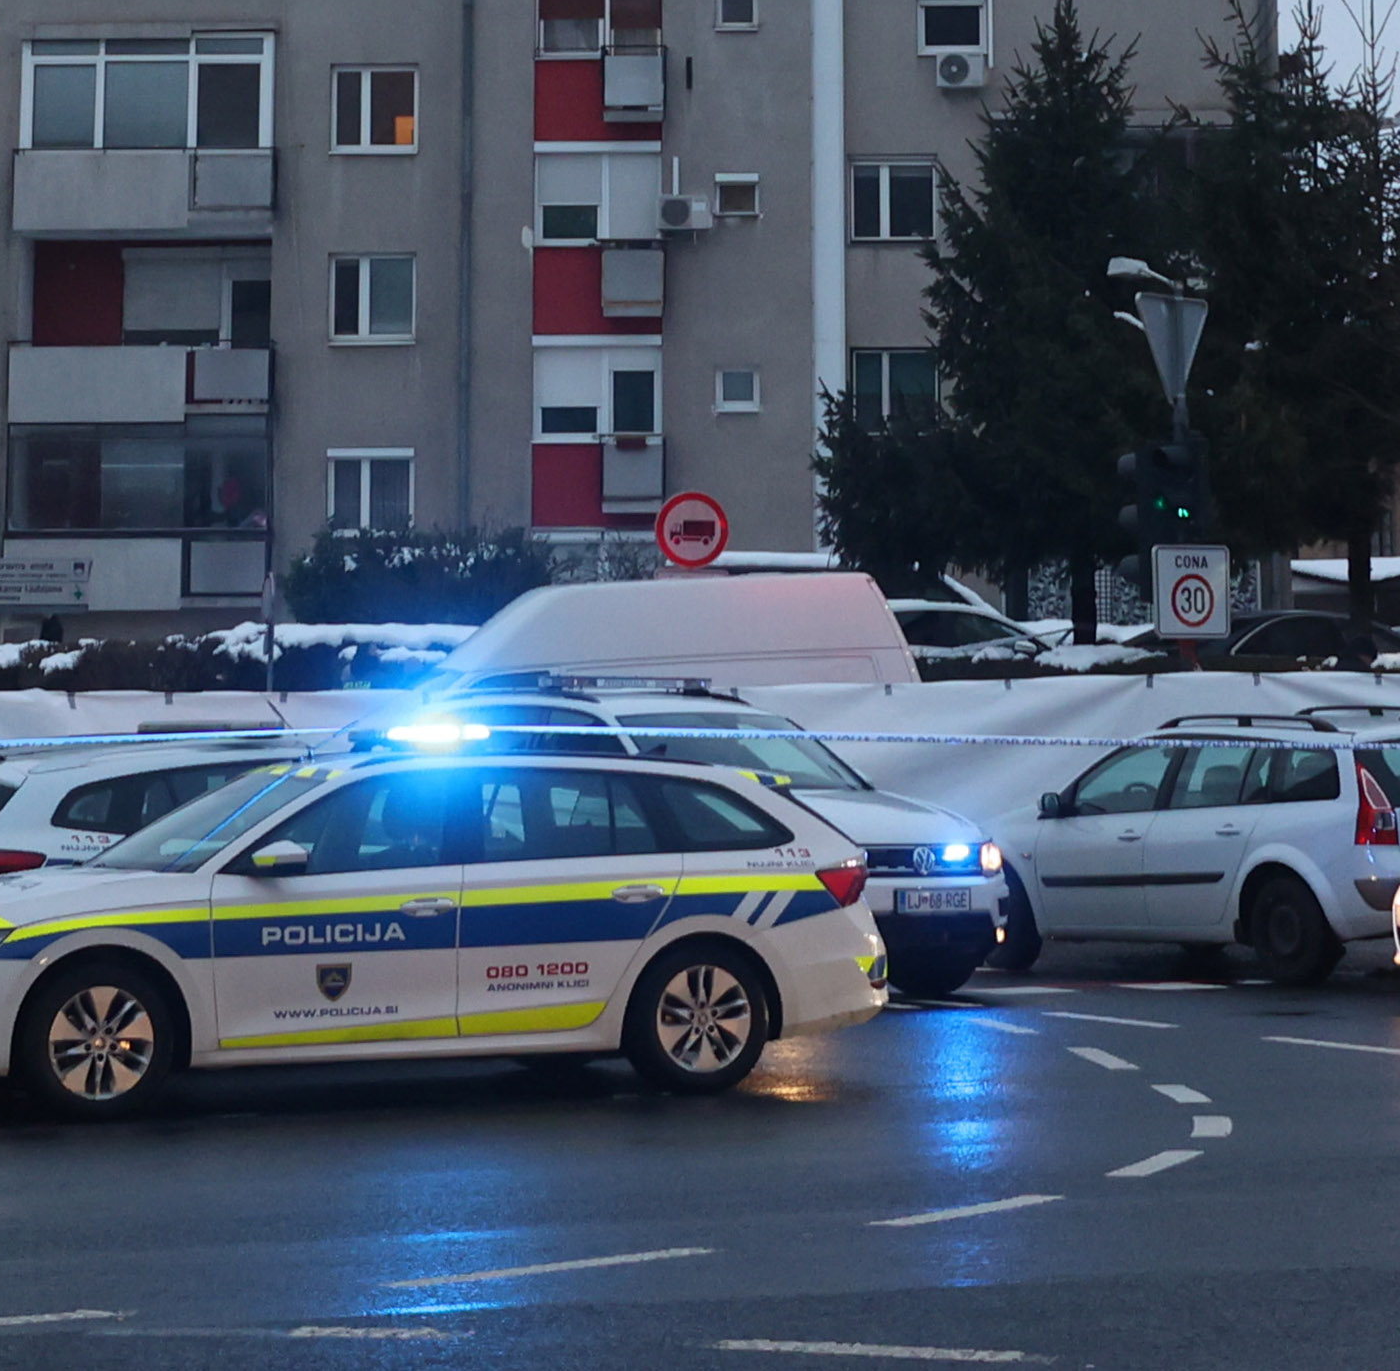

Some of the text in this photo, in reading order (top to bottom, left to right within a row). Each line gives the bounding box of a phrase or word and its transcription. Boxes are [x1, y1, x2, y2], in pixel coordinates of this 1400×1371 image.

[1175, 555, 1209, 569] CONA
[1181, 586, 1206, 615] 30
[261, 922, 406, 947] POLICIJA
[486, 961, 589, 980] 080 1200
[487, 979, 590, 993] ANONIMNI KLICI
[273, 1006, 399, 1021] WWW.POLICIJA.SI
